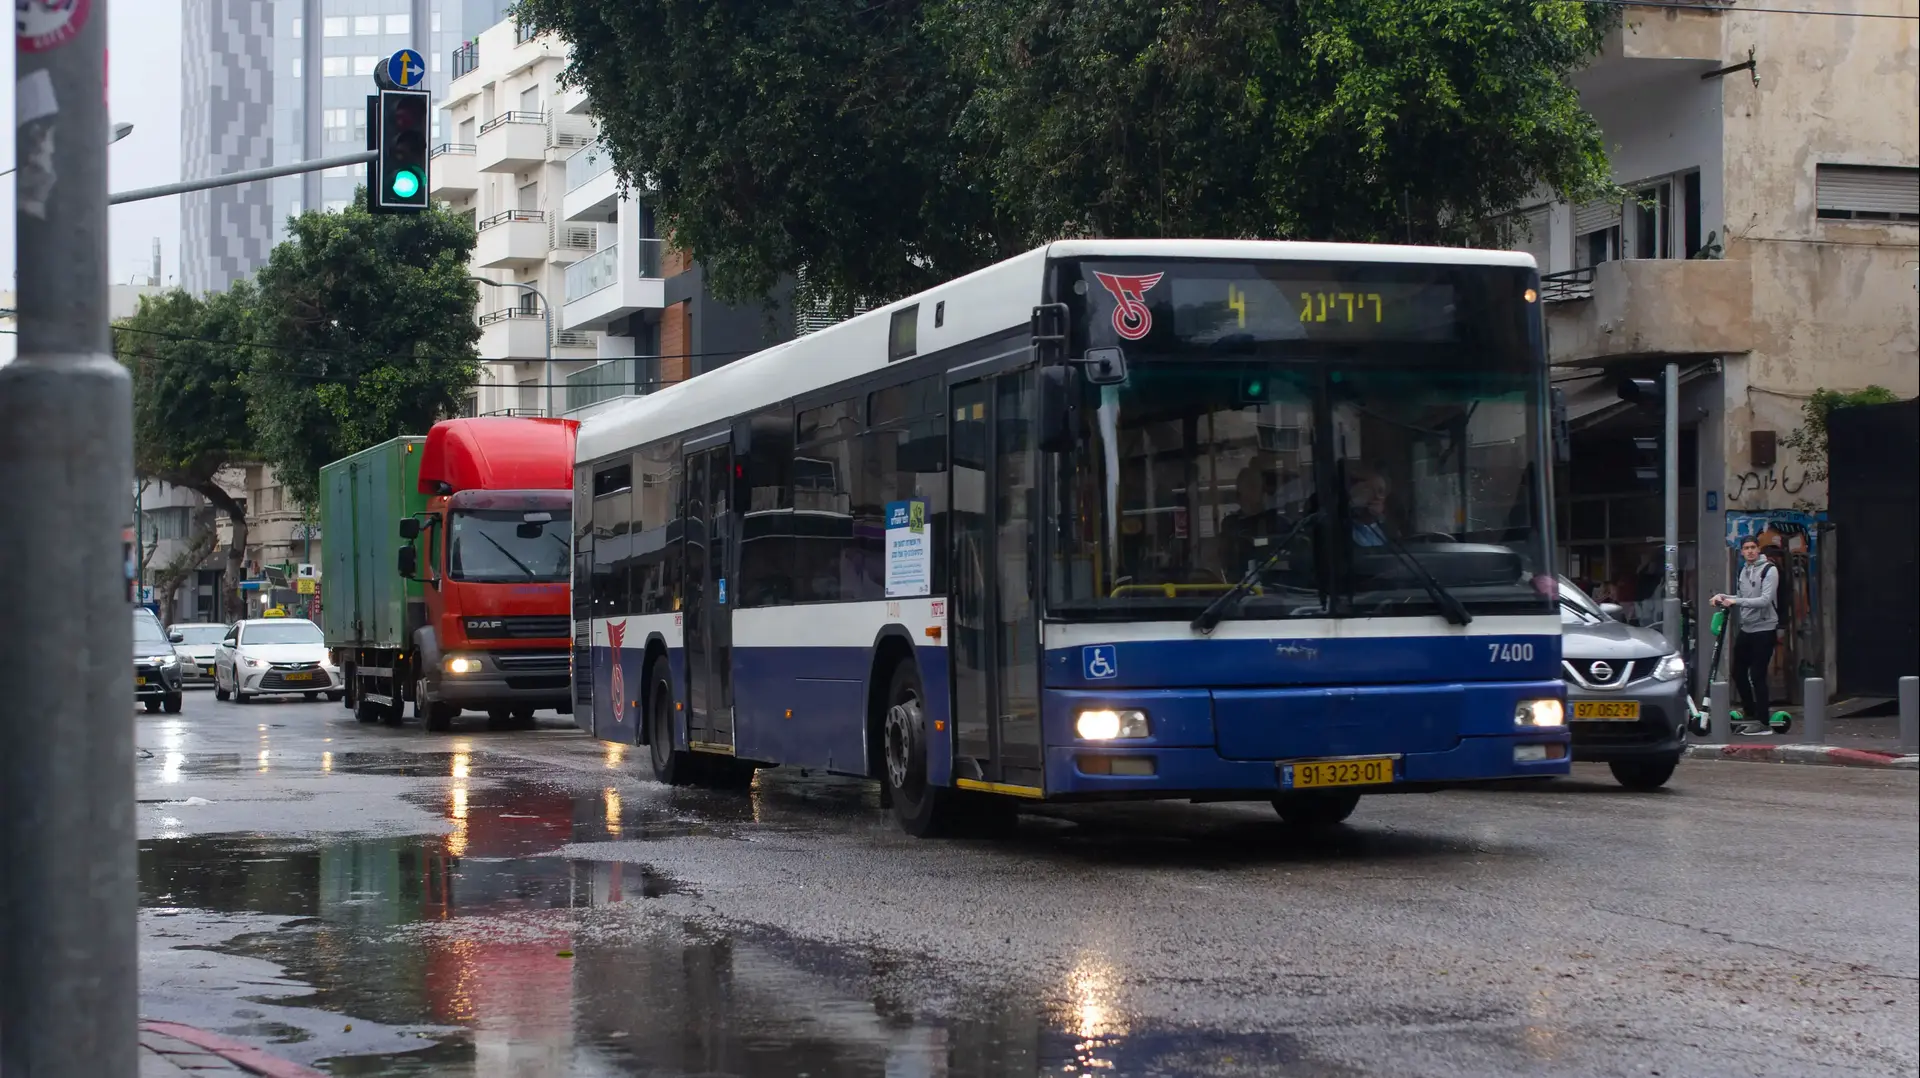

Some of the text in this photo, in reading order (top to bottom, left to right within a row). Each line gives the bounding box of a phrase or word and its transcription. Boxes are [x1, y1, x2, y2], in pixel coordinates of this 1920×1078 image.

[1228, 282, 1382, 329] 4 רידינג
[467, 620, 502, 629] DAF
[1488, 643, 1534, 663] 7400
